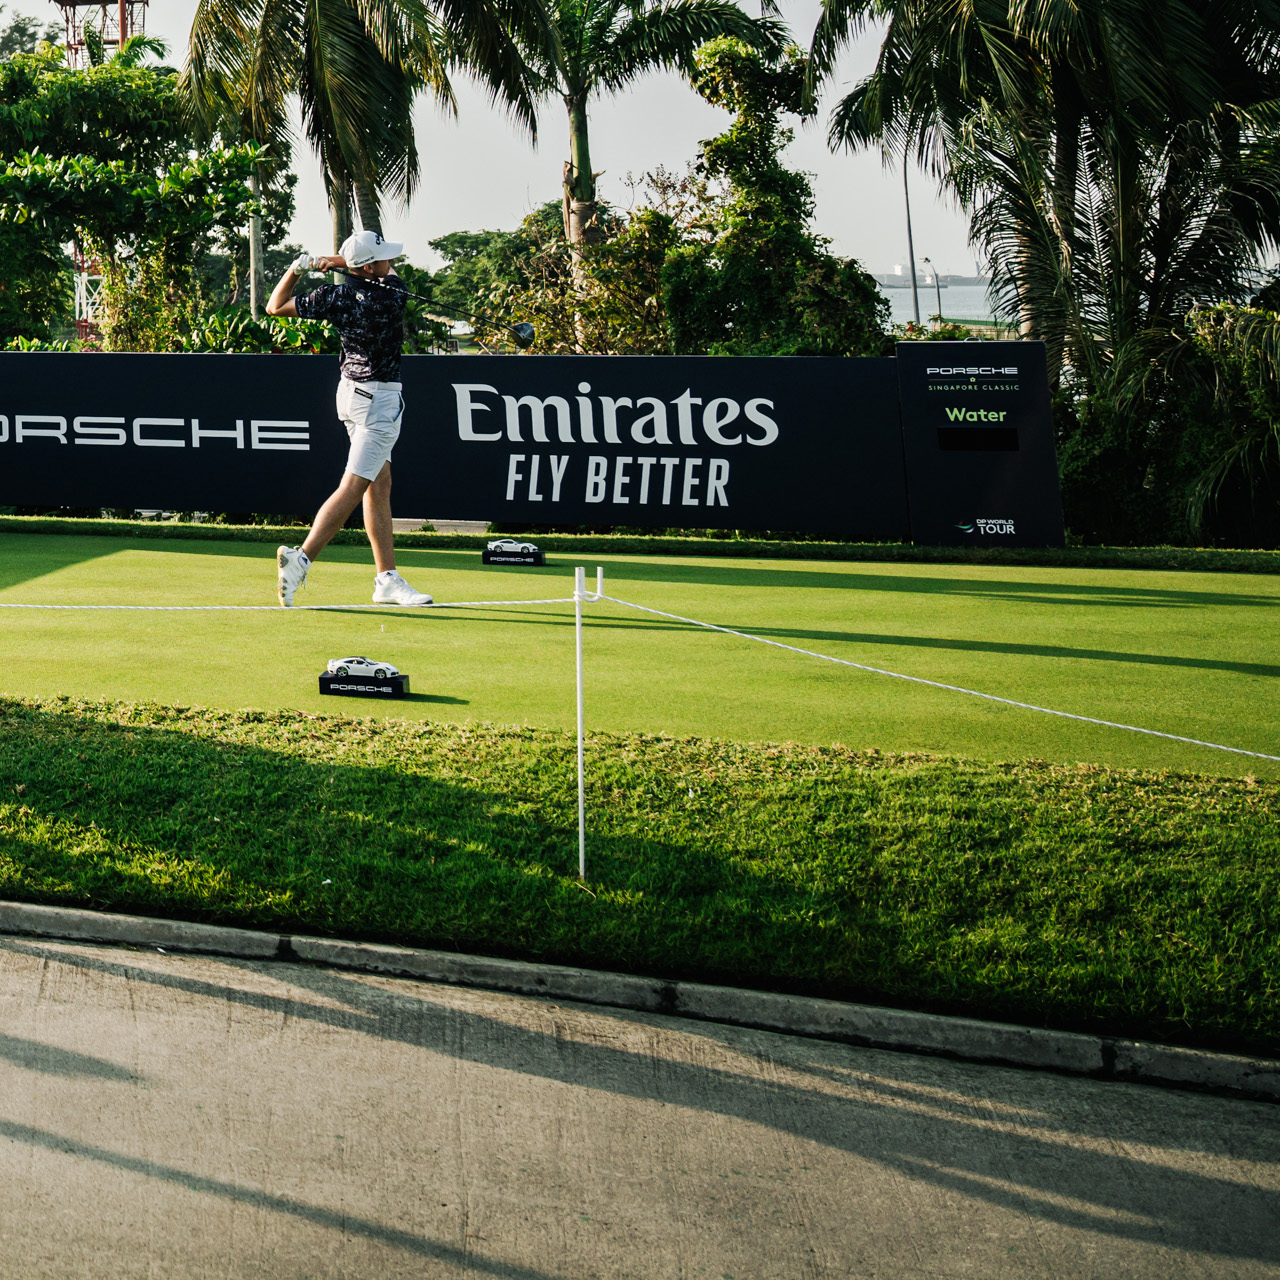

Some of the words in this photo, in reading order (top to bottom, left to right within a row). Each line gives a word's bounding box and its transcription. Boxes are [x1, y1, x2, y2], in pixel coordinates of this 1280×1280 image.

[926, 367, 1018, 375] PORSCHE
[450, 381, 779, 446] Emirates
[945, 407, 1007, 422] Water
[505, 453, 570, 502] FLY
[585, 455, 730, 507] BETTER
[977, 524, 1016, 535] TOUR
[329, 683, 393, 693] PORSCHE
